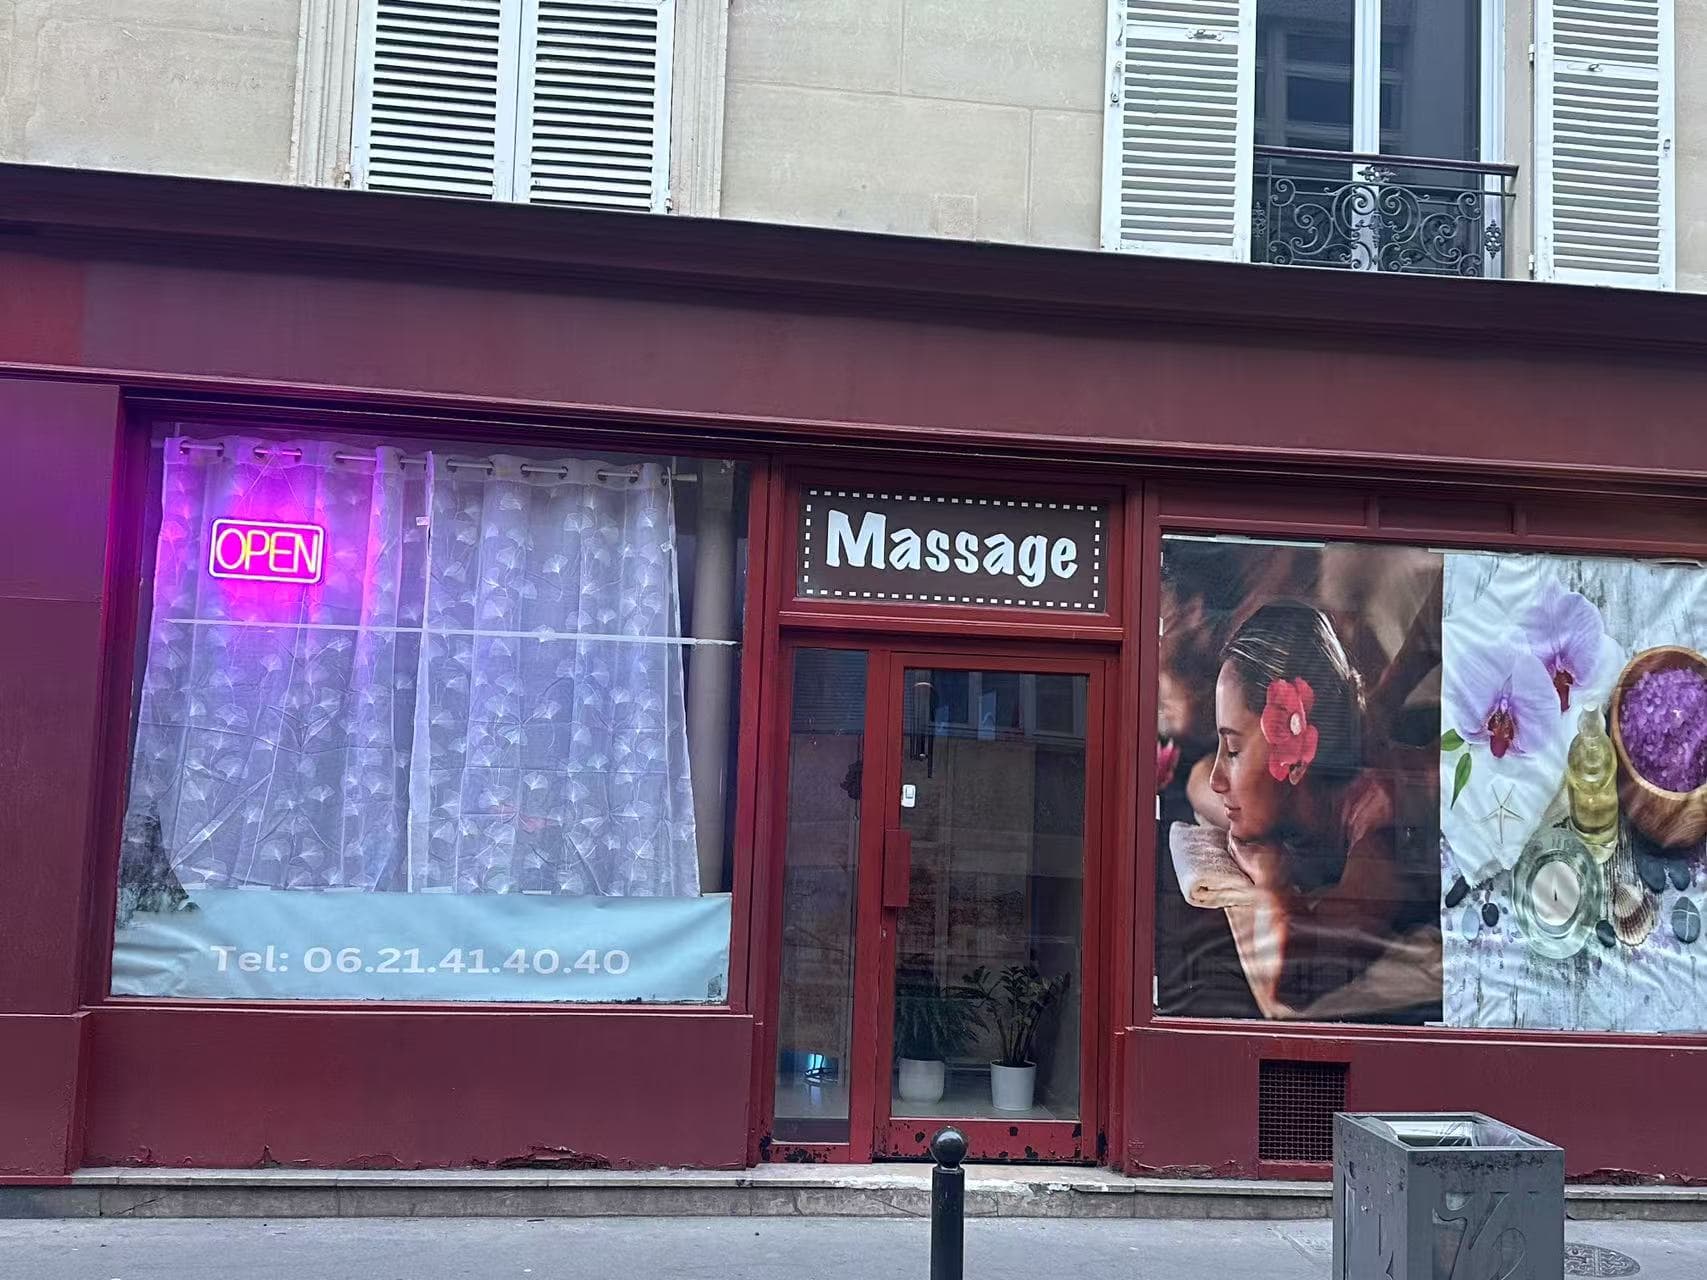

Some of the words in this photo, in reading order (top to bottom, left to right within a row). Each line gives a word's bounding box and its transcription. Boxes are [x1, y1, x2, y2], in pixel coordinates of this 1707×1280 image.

[216, 529, 318, 573] OPEN
[826, 509, 1078, 587] Massage
[210, 945, 288, 972] Tel:
[303, 946, 630, 975] 06.21.41.40.40
